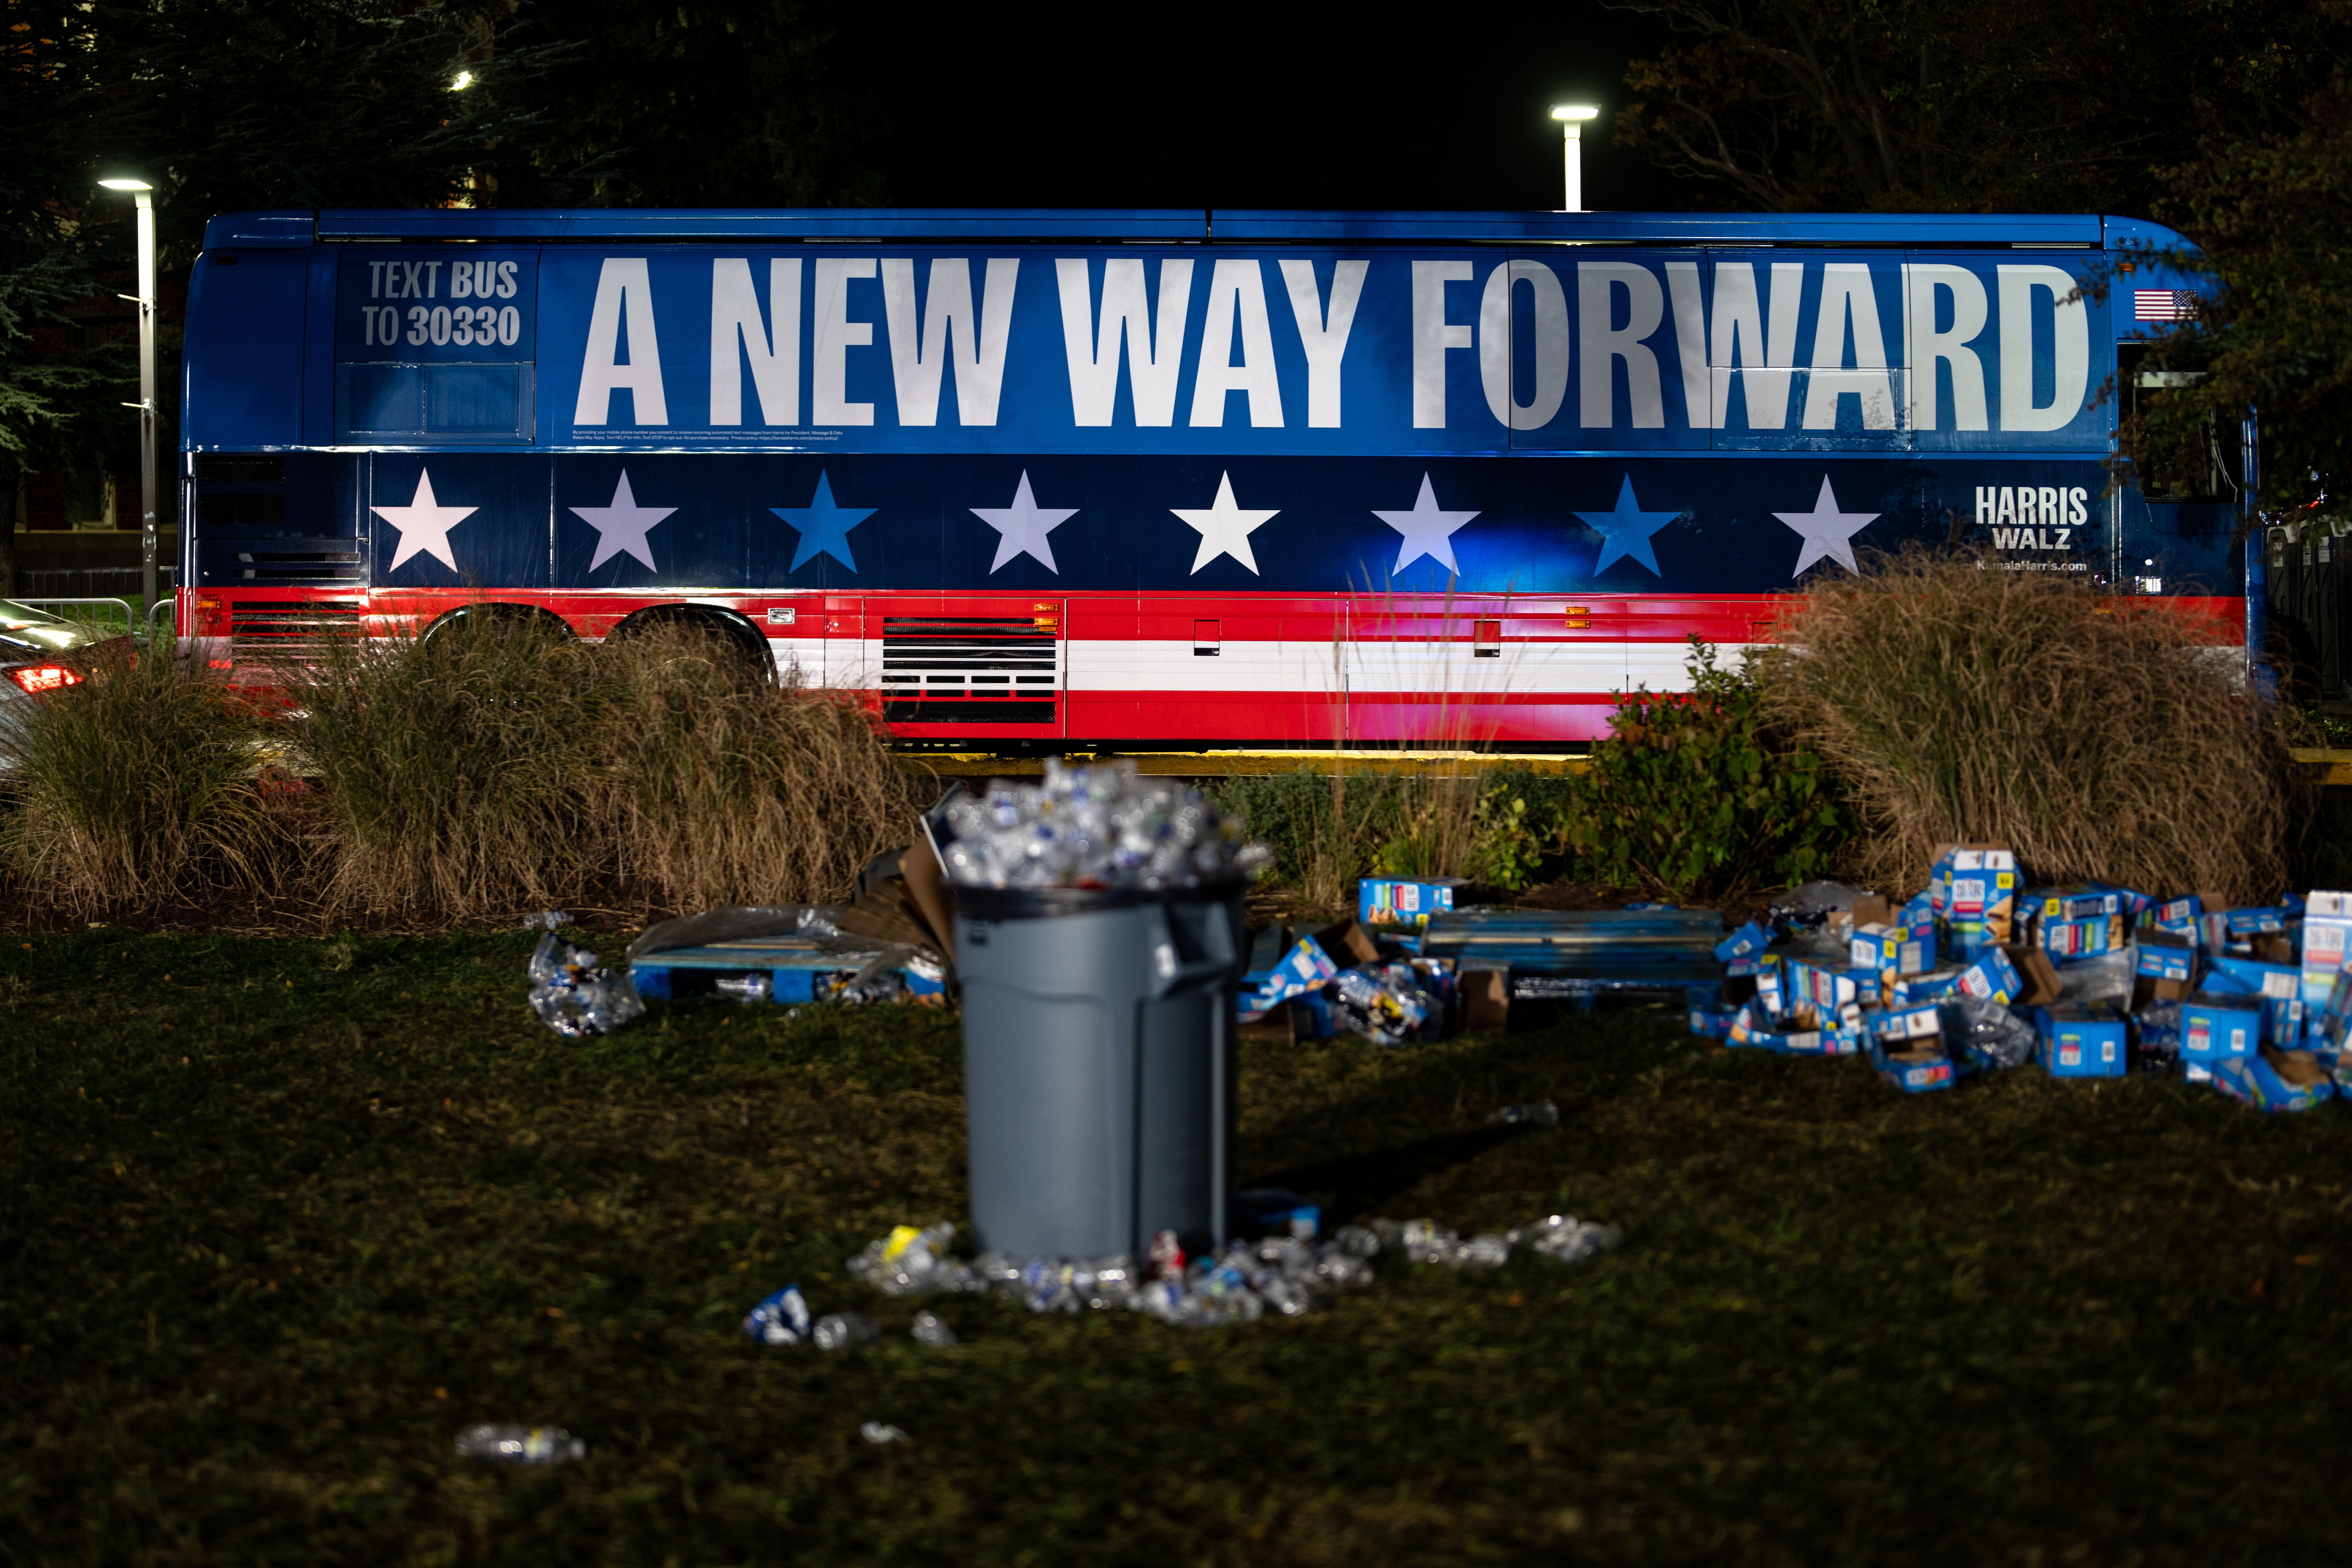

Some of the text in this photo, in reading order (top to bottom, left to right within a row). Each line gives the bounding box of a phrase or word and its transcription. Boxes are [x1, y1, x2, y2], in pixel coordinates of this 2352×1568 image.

[369, 261, 517, 298] TEXT BUS
[362, 306, 520, 346] TO 30330
[573, 258, 2089, 431] A NEW WAY FORWARD
[1976, 486, 2087, 525] HARRIS
[1992, 528, 2071, 549] WALZ
[1976, 560, 2087, 571] KmalaHarris.com
